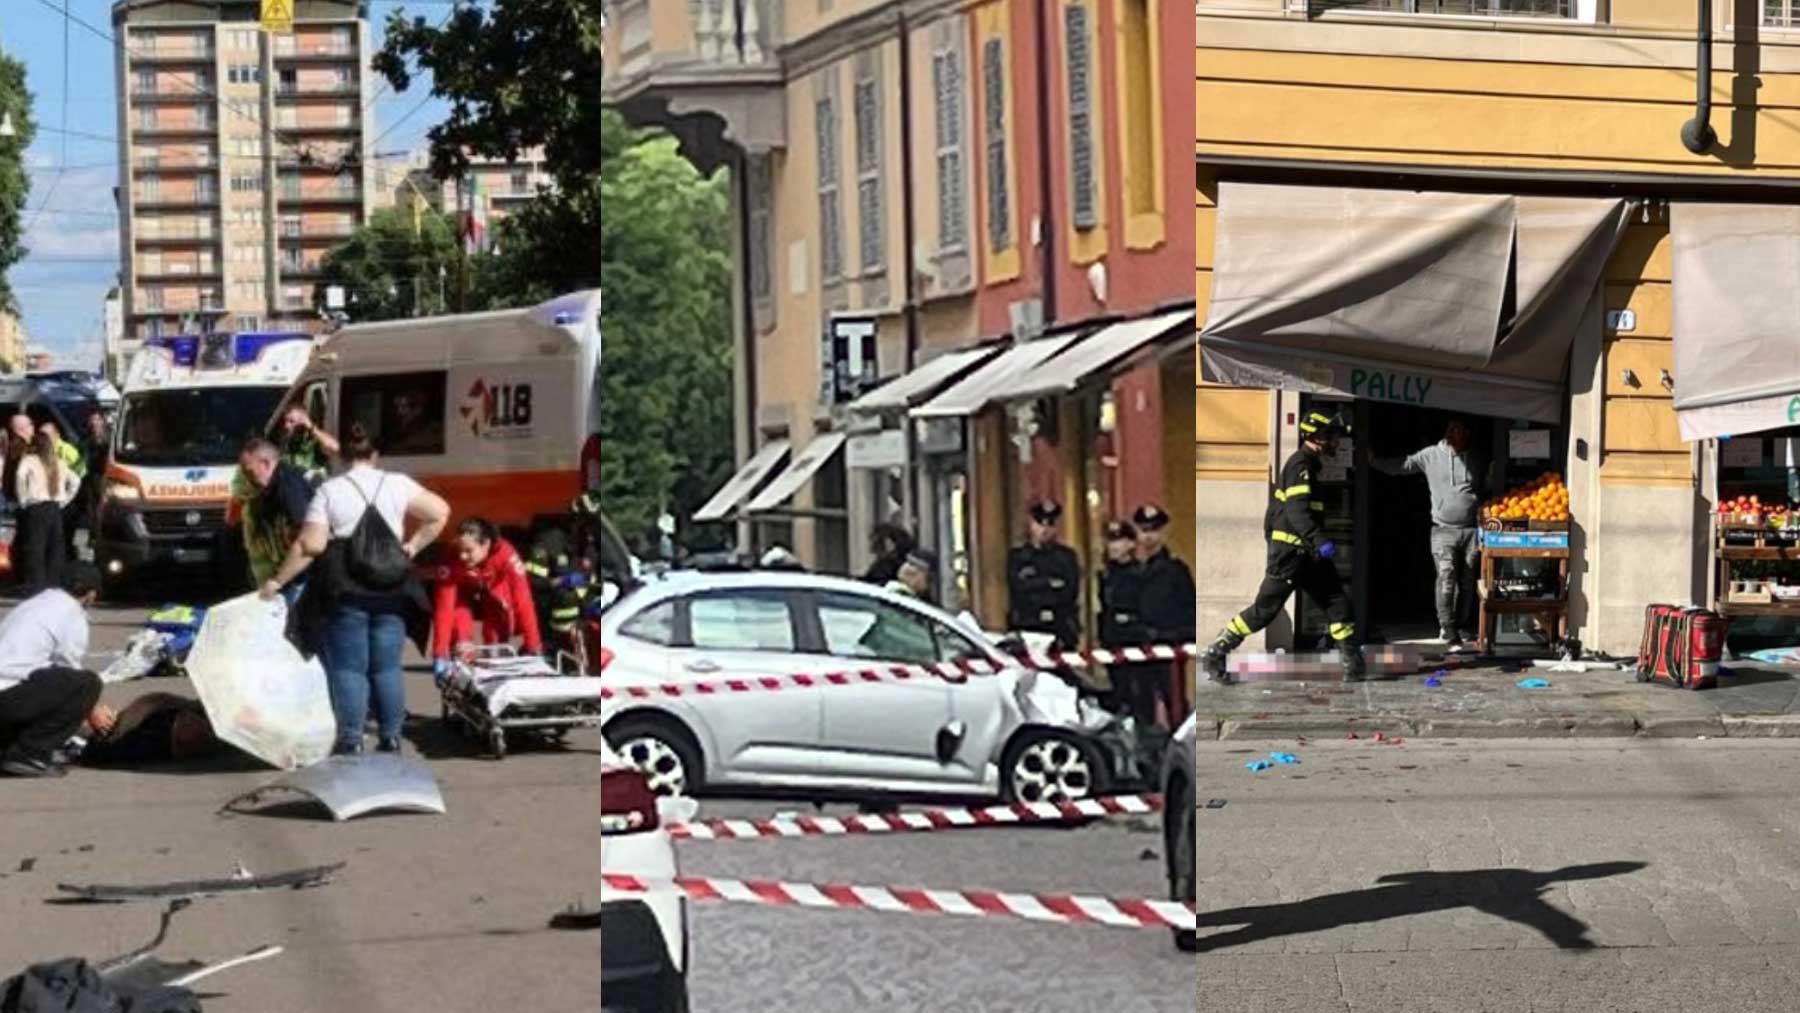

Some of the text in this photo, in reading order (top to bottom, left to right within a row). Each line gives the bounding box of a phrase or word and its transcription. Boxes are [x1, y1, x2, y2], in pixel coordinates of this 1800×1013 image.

[837, 322, 874, 376] T
[490, 384, 533, 427] 118
[1350, 367, 1433, 404] PALLY
